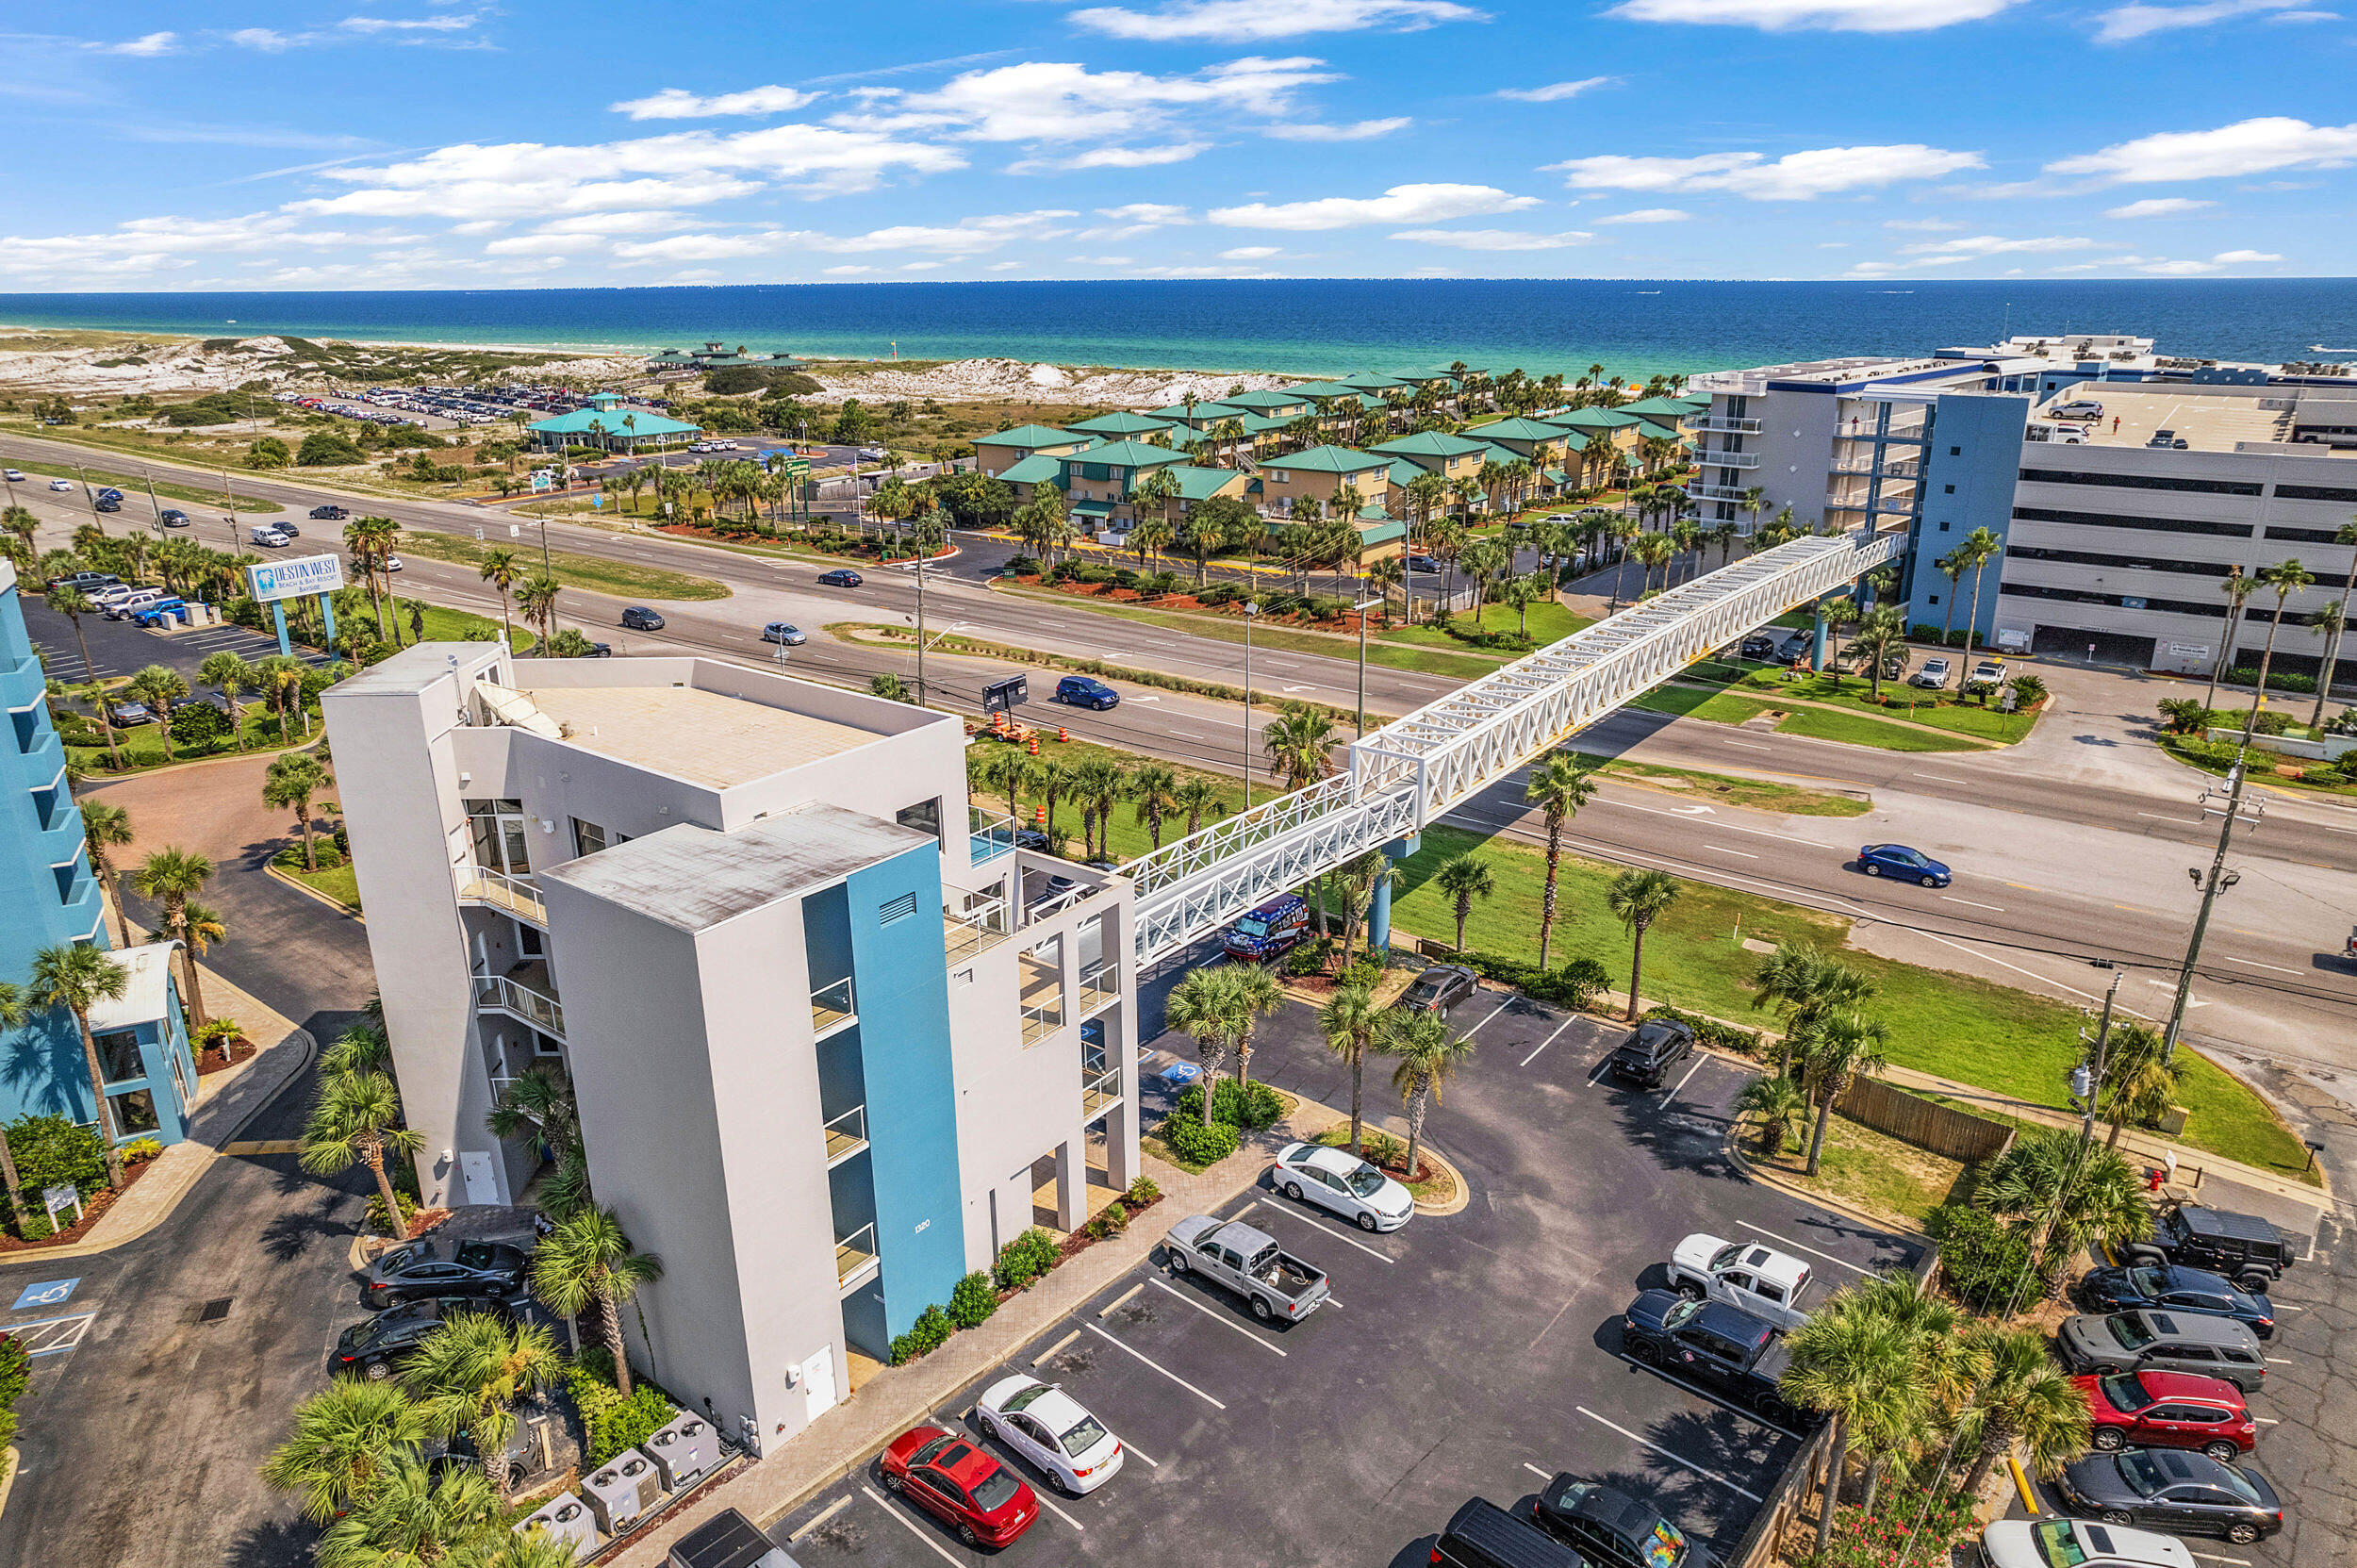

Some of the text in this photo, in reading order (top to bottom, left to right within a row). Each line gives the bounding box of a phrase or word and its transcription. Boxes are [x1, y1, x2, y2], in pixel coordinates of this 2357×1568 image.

[274, 559, 336, 581] DESTIN WEST
[915, 1218, 930, 1234] 1320
